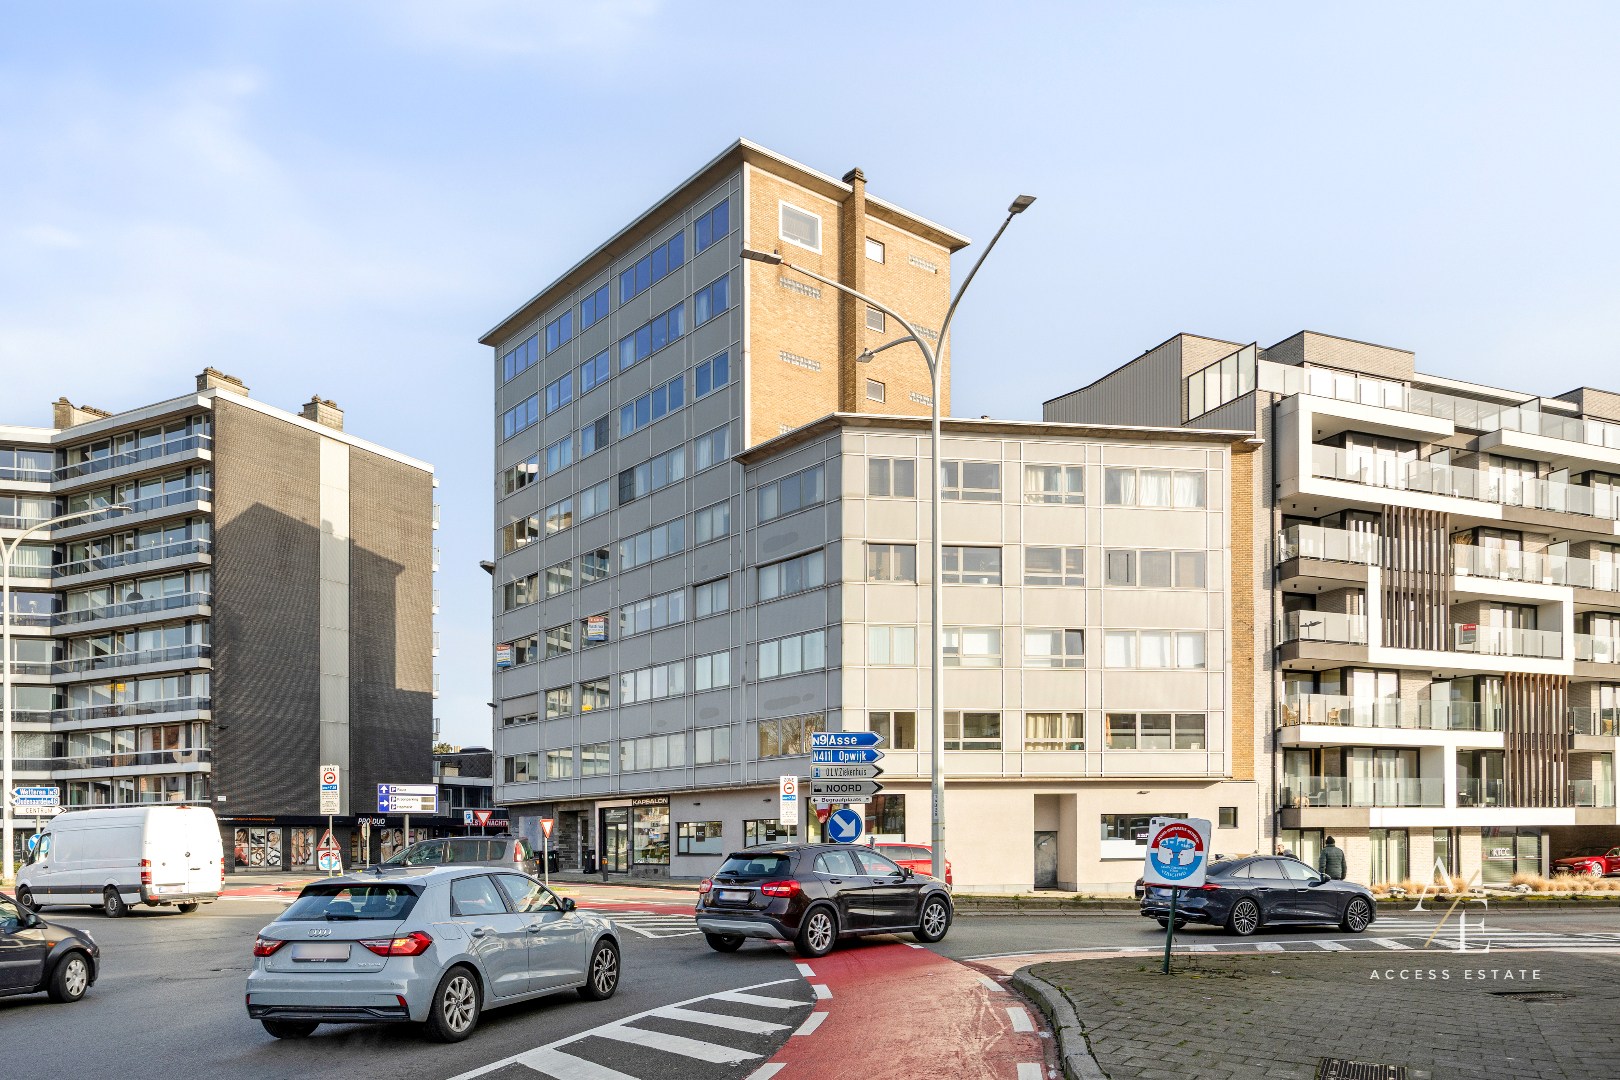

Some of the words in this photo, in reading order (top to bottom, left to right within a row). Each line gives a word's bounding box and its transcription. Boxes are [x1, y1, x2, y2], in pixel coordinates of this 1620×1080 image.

[812, 734, 827, 745] N9
[828, 734, 858, 745] Asse
[813, 750, 831, 762] N411
[838, 750, 867, 763] Opwijk
[826, 784, 862, 792] NOORD
[632, 797, 668, 805] KAPSALON
